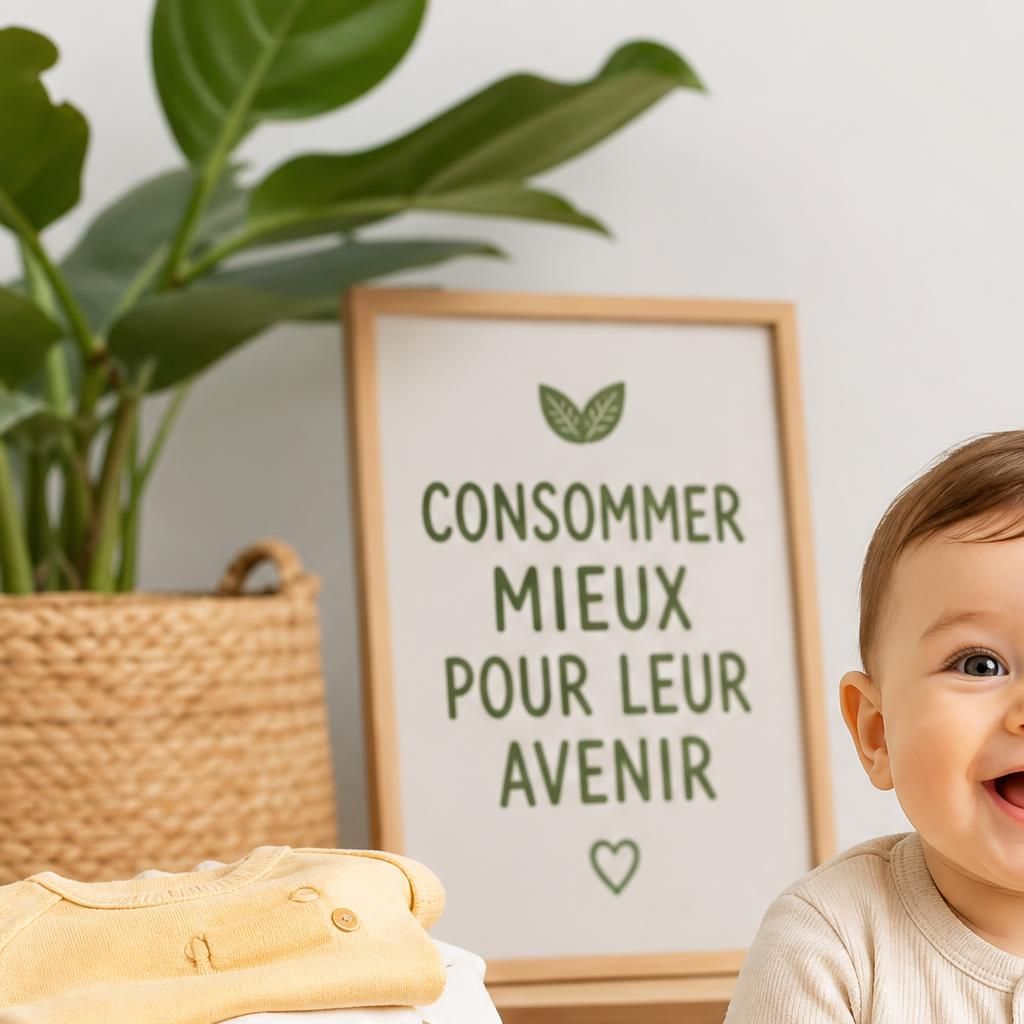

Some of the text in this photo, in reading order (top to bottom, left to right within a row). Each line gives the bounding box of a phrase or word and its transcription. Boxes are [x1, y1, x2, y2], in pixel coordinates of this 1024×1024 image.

[421, 481, 746, 544] CONSOMMER
[493, 565, 692, 633] MIEUX
[444, 651, 752, 720] POUR LEUR
[499, 735, 717, 808] AVENIR
